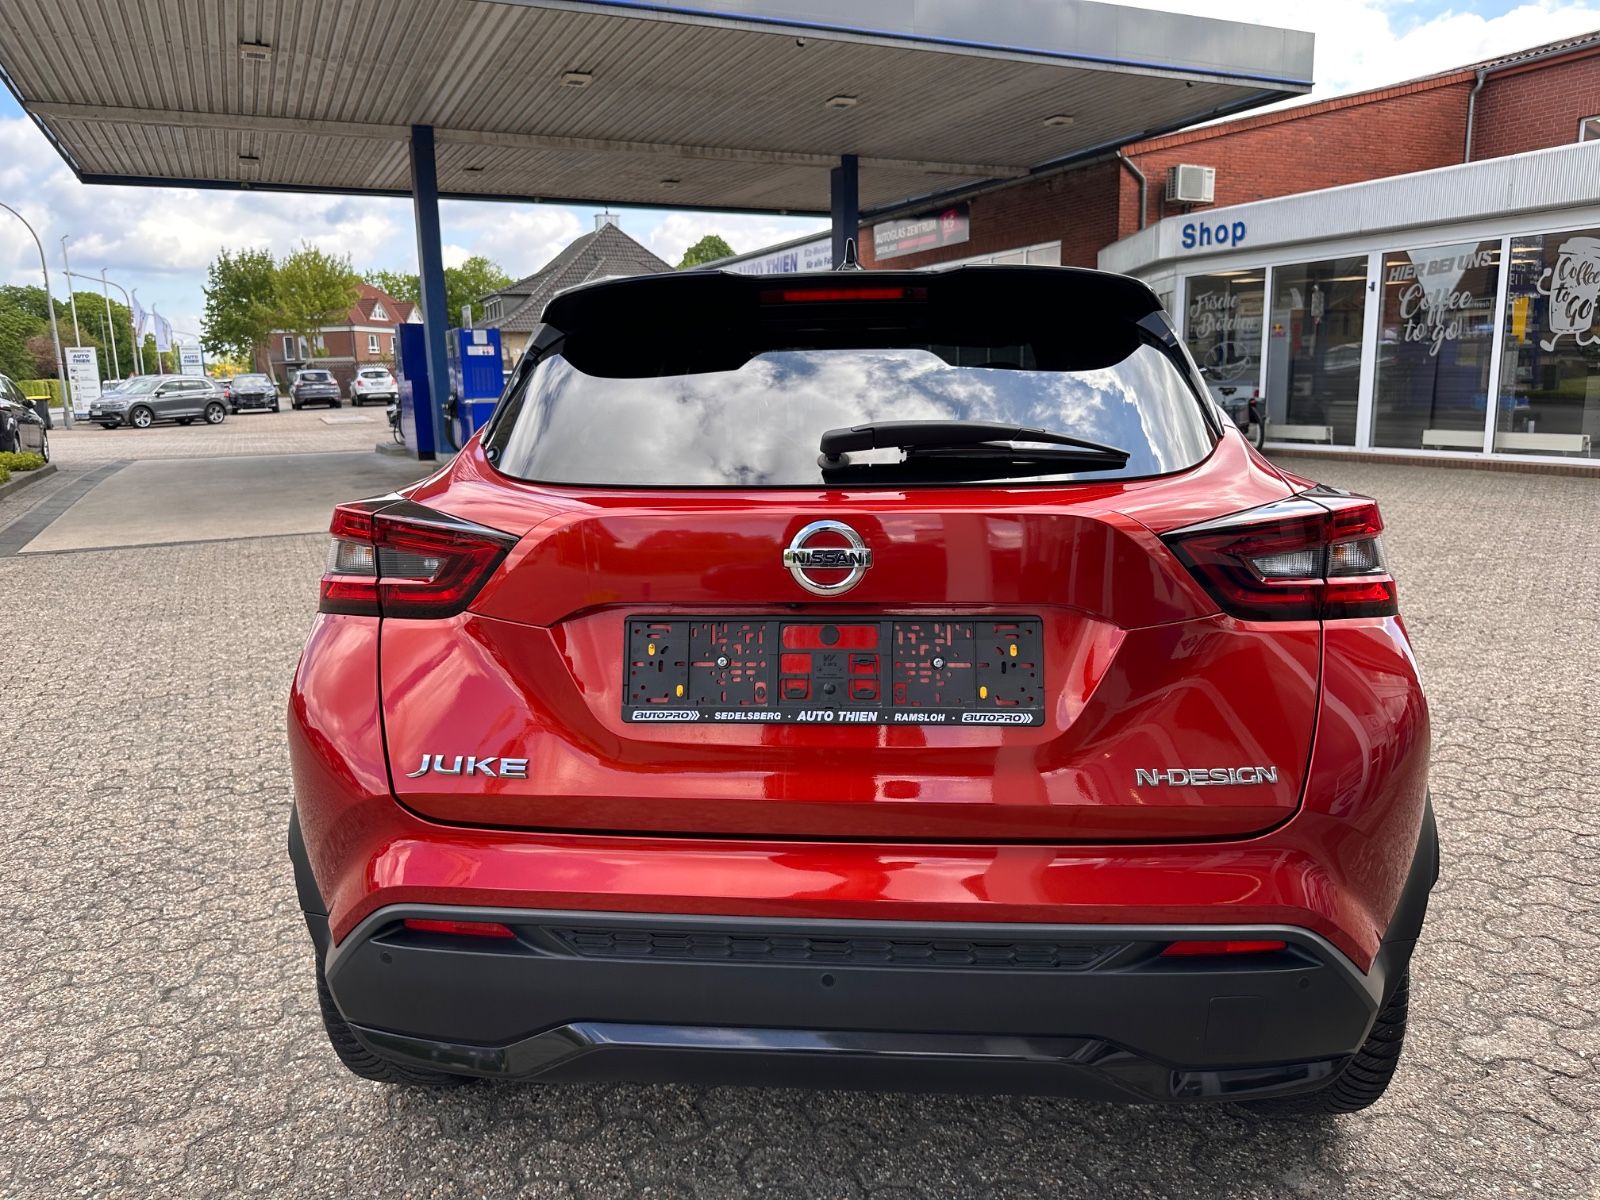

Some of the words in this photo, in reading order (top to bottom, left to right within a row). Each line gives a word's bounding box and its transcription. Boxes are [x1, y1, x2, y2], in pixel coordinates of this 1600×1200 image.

[876, 227, 906, 244] AUTOGLAS
[907, 219, 937, 238] ZENTRUM
[1182, 221, 1246, 249] Shop
[766, 253, 798, 272] THIEN
[1389, 262, 1425, 282] HIER
[1426, 257, 1456, 276] BEI
[1457, 249, 1494, 271] UNS
[1559, 256, 1600, 287] Coffee
[1190, 290, 1239, 318] Frische
[1398, 283, 1472, 327] Coffee
[1552, 283, 1571, 304] to
[1403, 319, 1426, 342] to
[1429, 317, 1464, 357] go!
[792, 552, 863, 564] NISSAN
[714, 711, 782, 720] SEDELSBERG
[796, 710, 834, 722] AUTO
[838, 711, 878, 722] THIEN
[894, 713, 946, 722] RAMSLOH
[405, 754, 528, 778] JUKE
[1135, 766, 1278, 787] N-DESIGN
